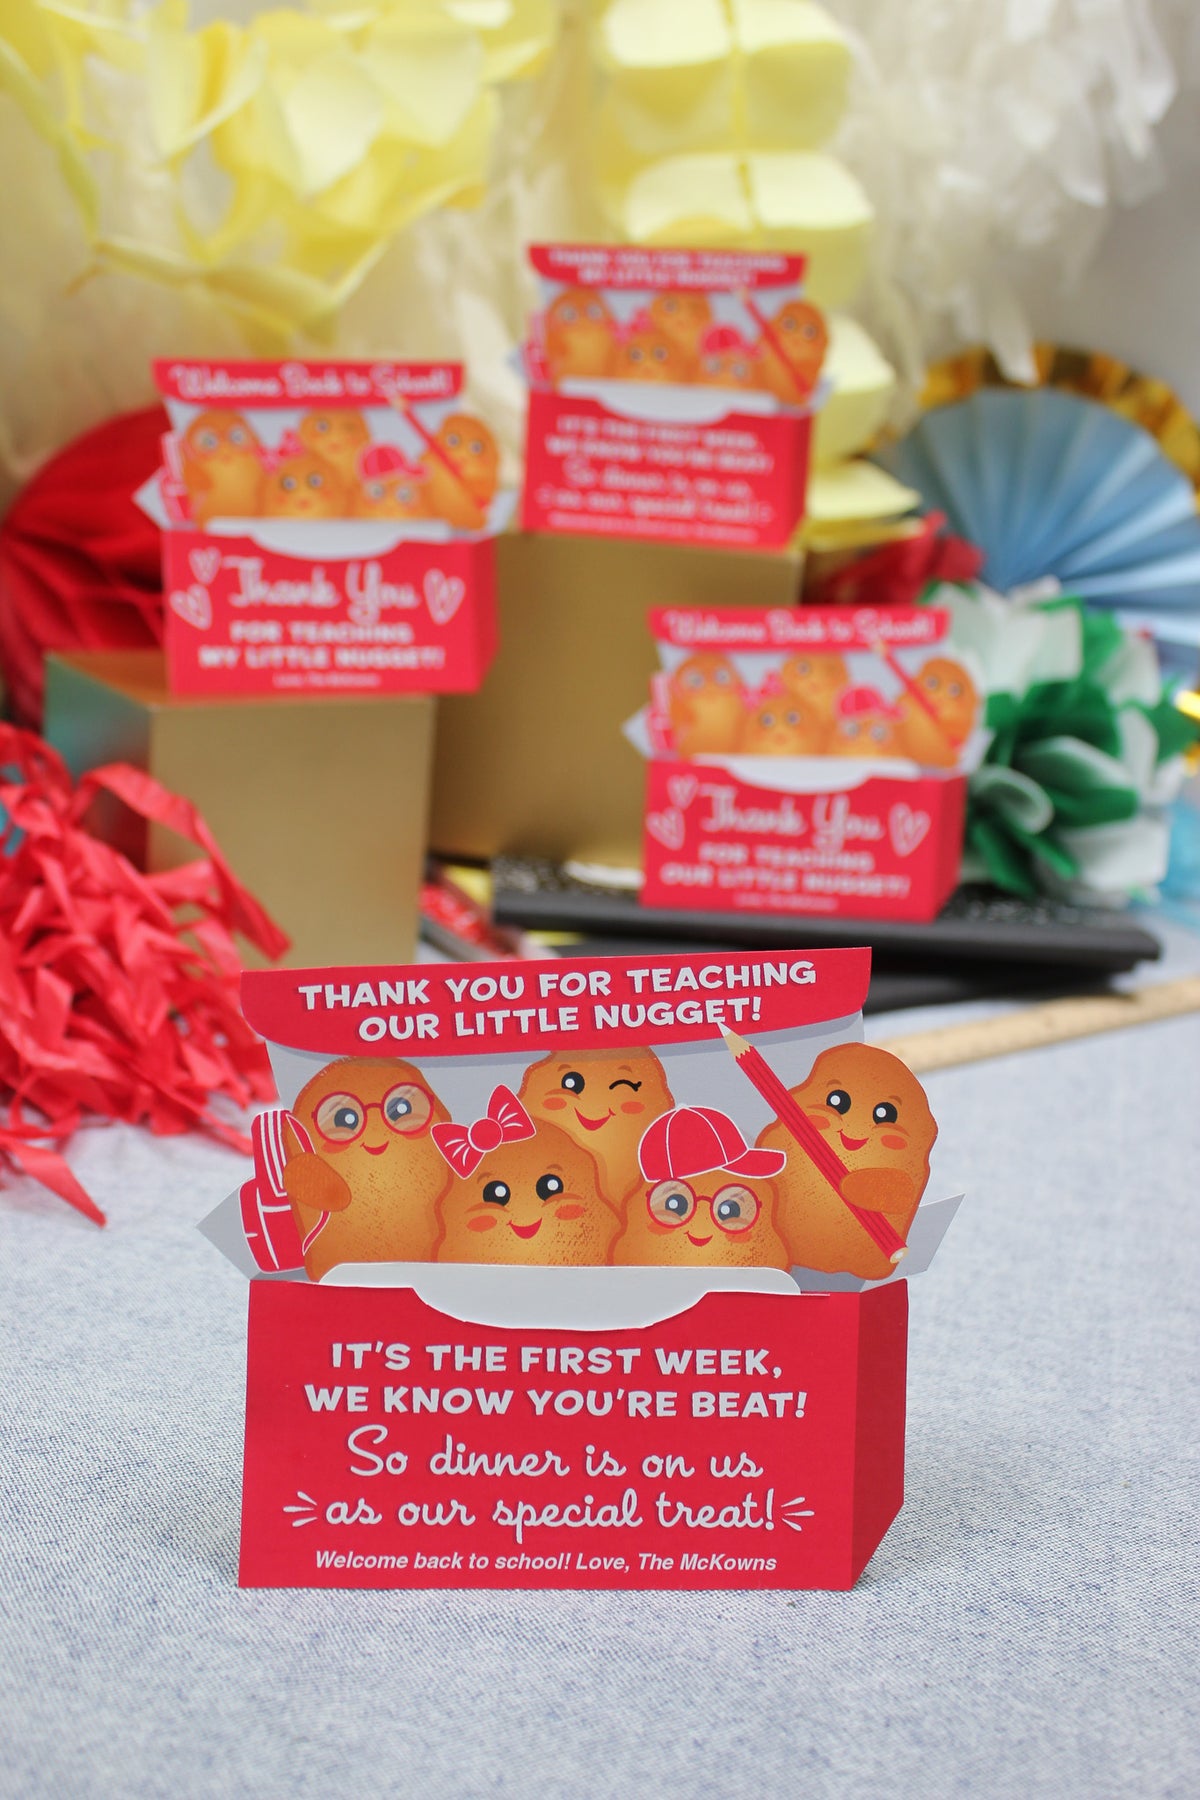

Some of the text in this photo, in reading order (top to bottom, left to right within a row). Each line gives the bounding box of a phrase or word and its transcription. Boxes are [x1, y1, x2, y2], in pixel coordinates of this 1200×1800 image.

[223, 557, 418, 624] Thank You
[232, 622, 412, 644] FOR TEACHING
[200, 647, 444, 669] MY LITTLE NUGGET!
[700, 784, 883, 852] Thank You
[701, 843, 873, 873] FOR TEACHING
[662, 863, 909, 898] OUR LITTLE NUGGET!
[298, 960, 817, 1010] THANK YOU FOR TEACHING
[358, 996, 762, 1042] OUR LITTLE NUGGET!
[332, 1341, 782, 1379] IT'S THE FIRST WEEK,
[304, 1384, 808, 1419] WE KNOW YOU'RE BEAT!
[347, 1424, 764, 1479] So dinner is on us
[325, 1488, 776, 1545] as our special treat!
[316, 1551, 777, 1573] Welcome back to school! Love, The McKowns
